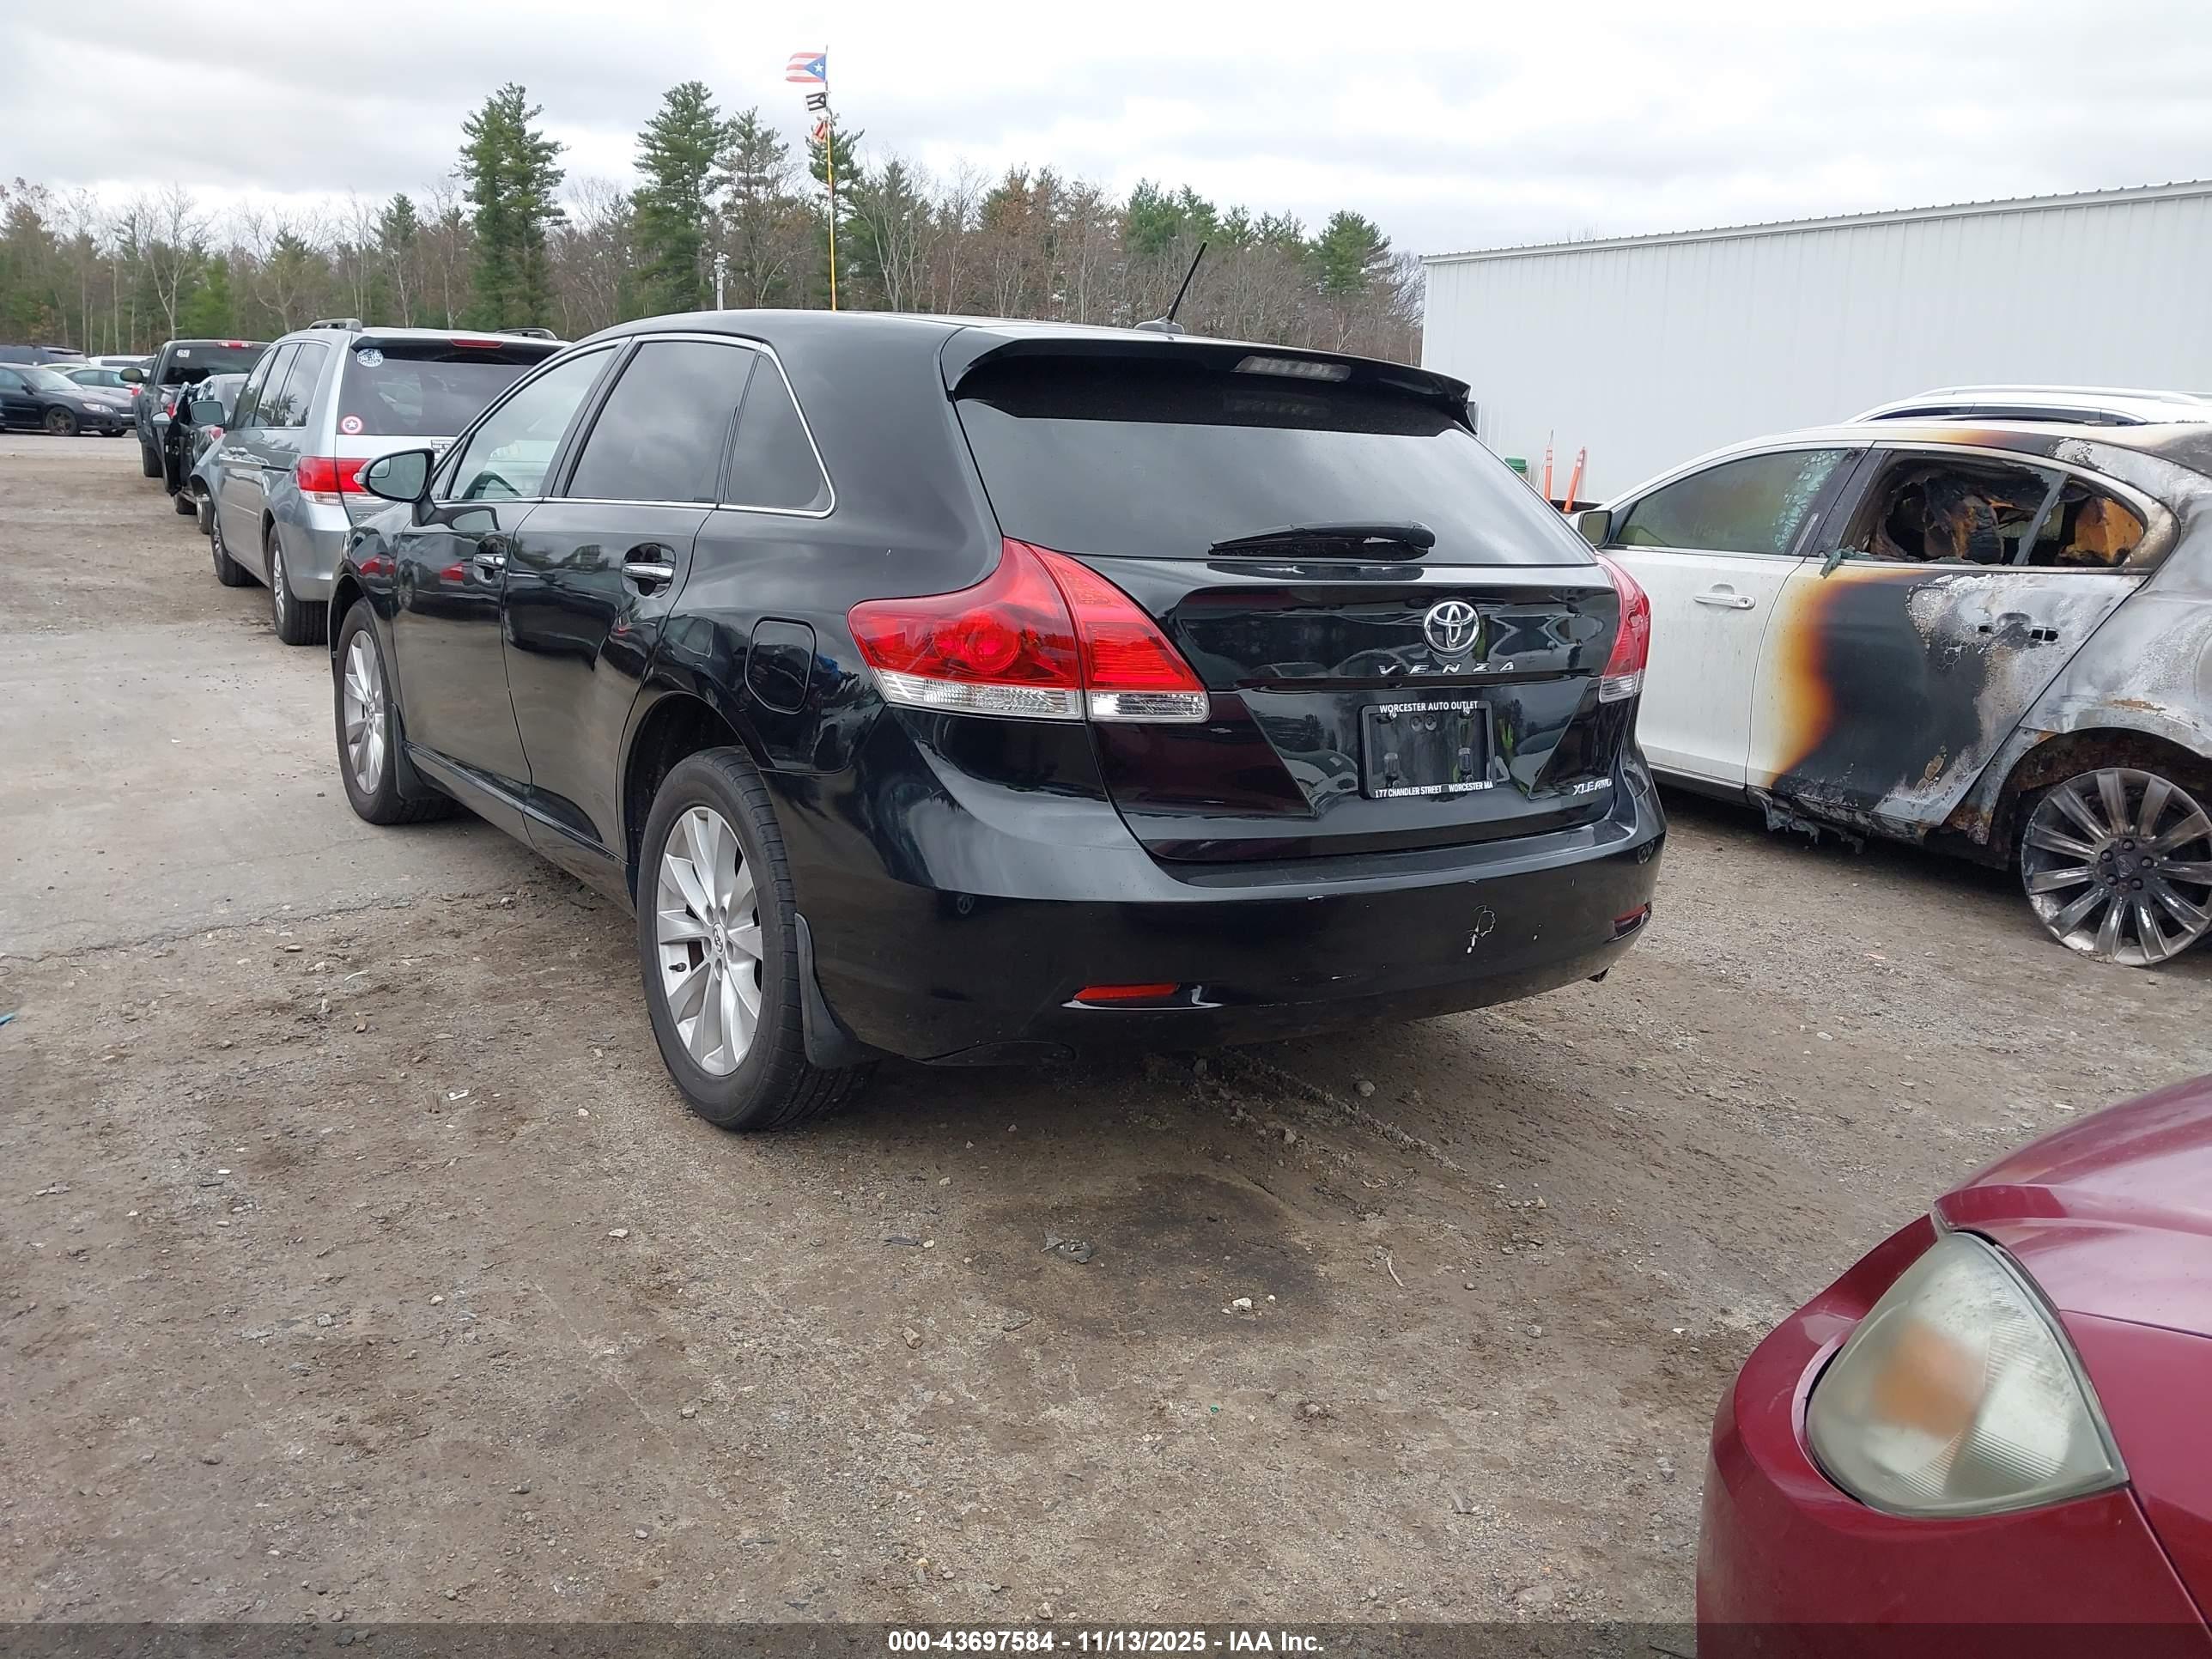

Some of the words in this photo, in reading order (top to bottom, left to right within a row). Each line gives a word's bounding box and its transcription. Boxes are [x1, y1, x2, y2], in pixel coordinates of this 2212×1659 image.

[1378, 661, 1515, 676] VENZA
[1379, 702, 1426, 714] WORCESTER
[1428, 702, 1449, 711] AUTO
[1450, 701, 1478, 710] OUTLET
[1375, 789, 1388, 799] 177
[1389, 787, 1420, 798] CHANDLER
[1420, 785, 1442, 795] STREET
[1448, 781, 1483, 793] WORCESTER
[1484, 781, 1493, 789] MA
[1572, 781, 1595, 796] XLE
